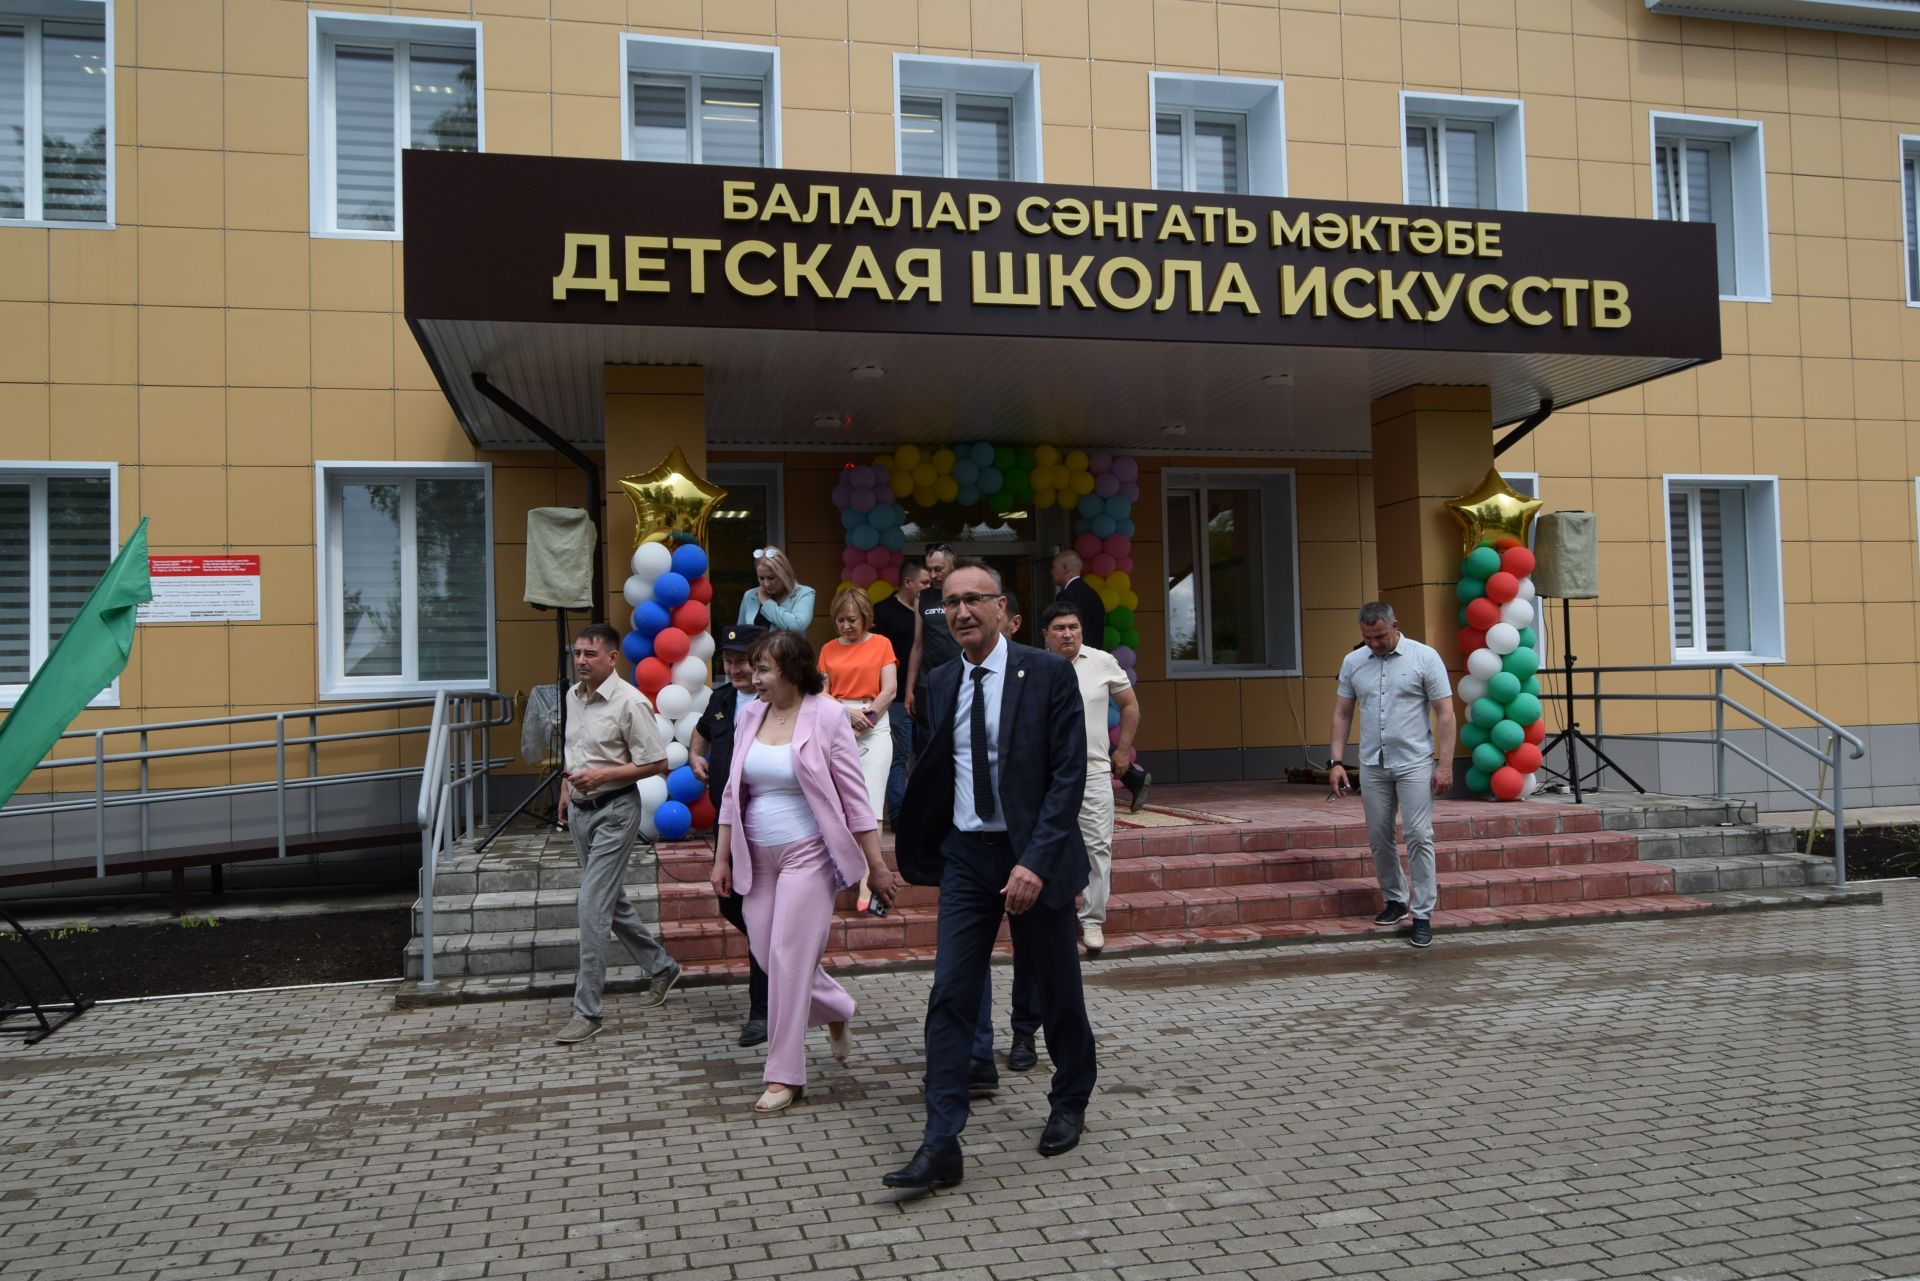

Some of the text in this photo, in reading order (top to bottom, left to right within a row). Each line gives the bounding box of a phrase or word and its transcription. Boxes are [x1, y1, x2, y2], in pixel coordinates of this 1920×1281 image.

[722, 180, 1503, 258] БАЛАЛАР СӘНГАТЬ МӘКТӘБЕ
[552, 232, 1632, 330] ДЕТСКАЯ ШКОЛА ИСКУССТВ
